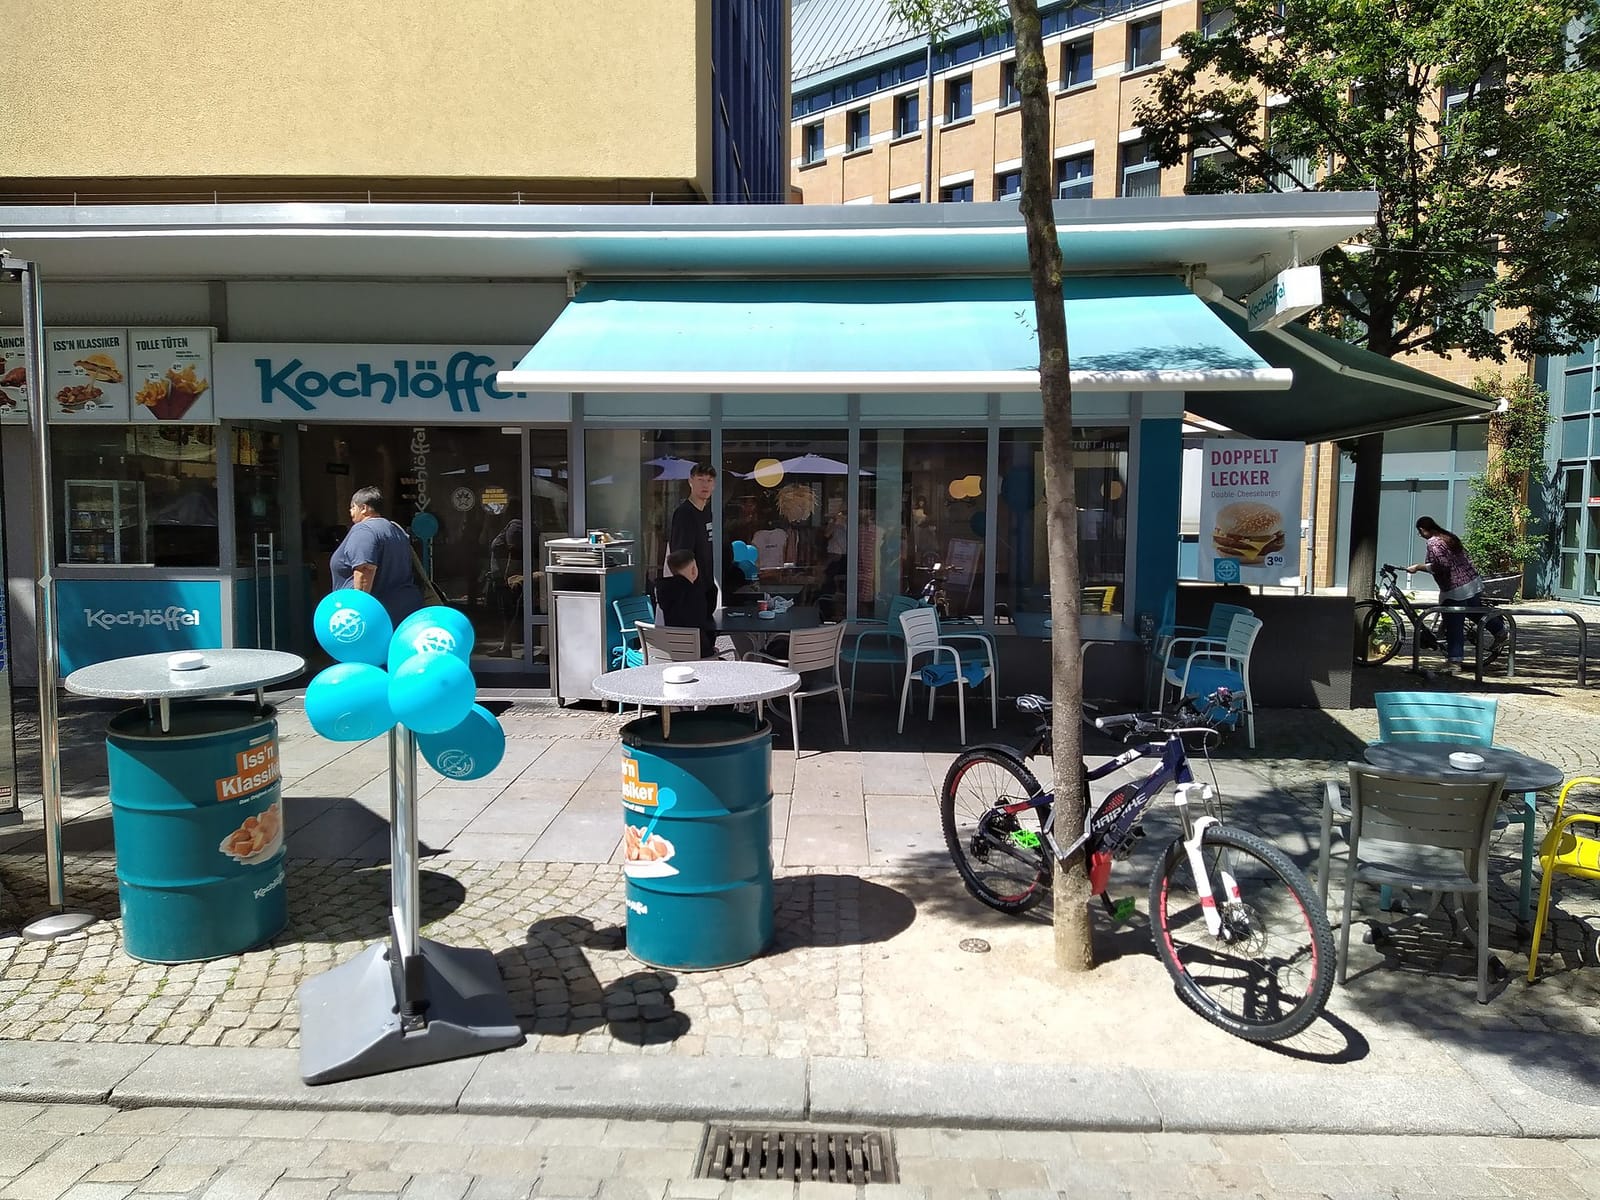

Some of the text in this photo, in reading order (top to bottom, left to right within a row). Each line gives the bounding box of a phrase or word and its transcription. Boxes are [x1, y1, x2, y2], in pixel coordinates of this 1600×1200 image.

[0, 337, 25, 348] ÄHNCH
[77, 337, 120, 349] KLASSIKER
[136, 337, 188, 351] TOLLE TÜTEN
[1211, 449, 1279, 465] DOPPELT
[1211, 471, 1270, 486] LECKER
[84, 606, 200, 630] Kochlöffel
[242, 745, 274, 770] Iss'n
